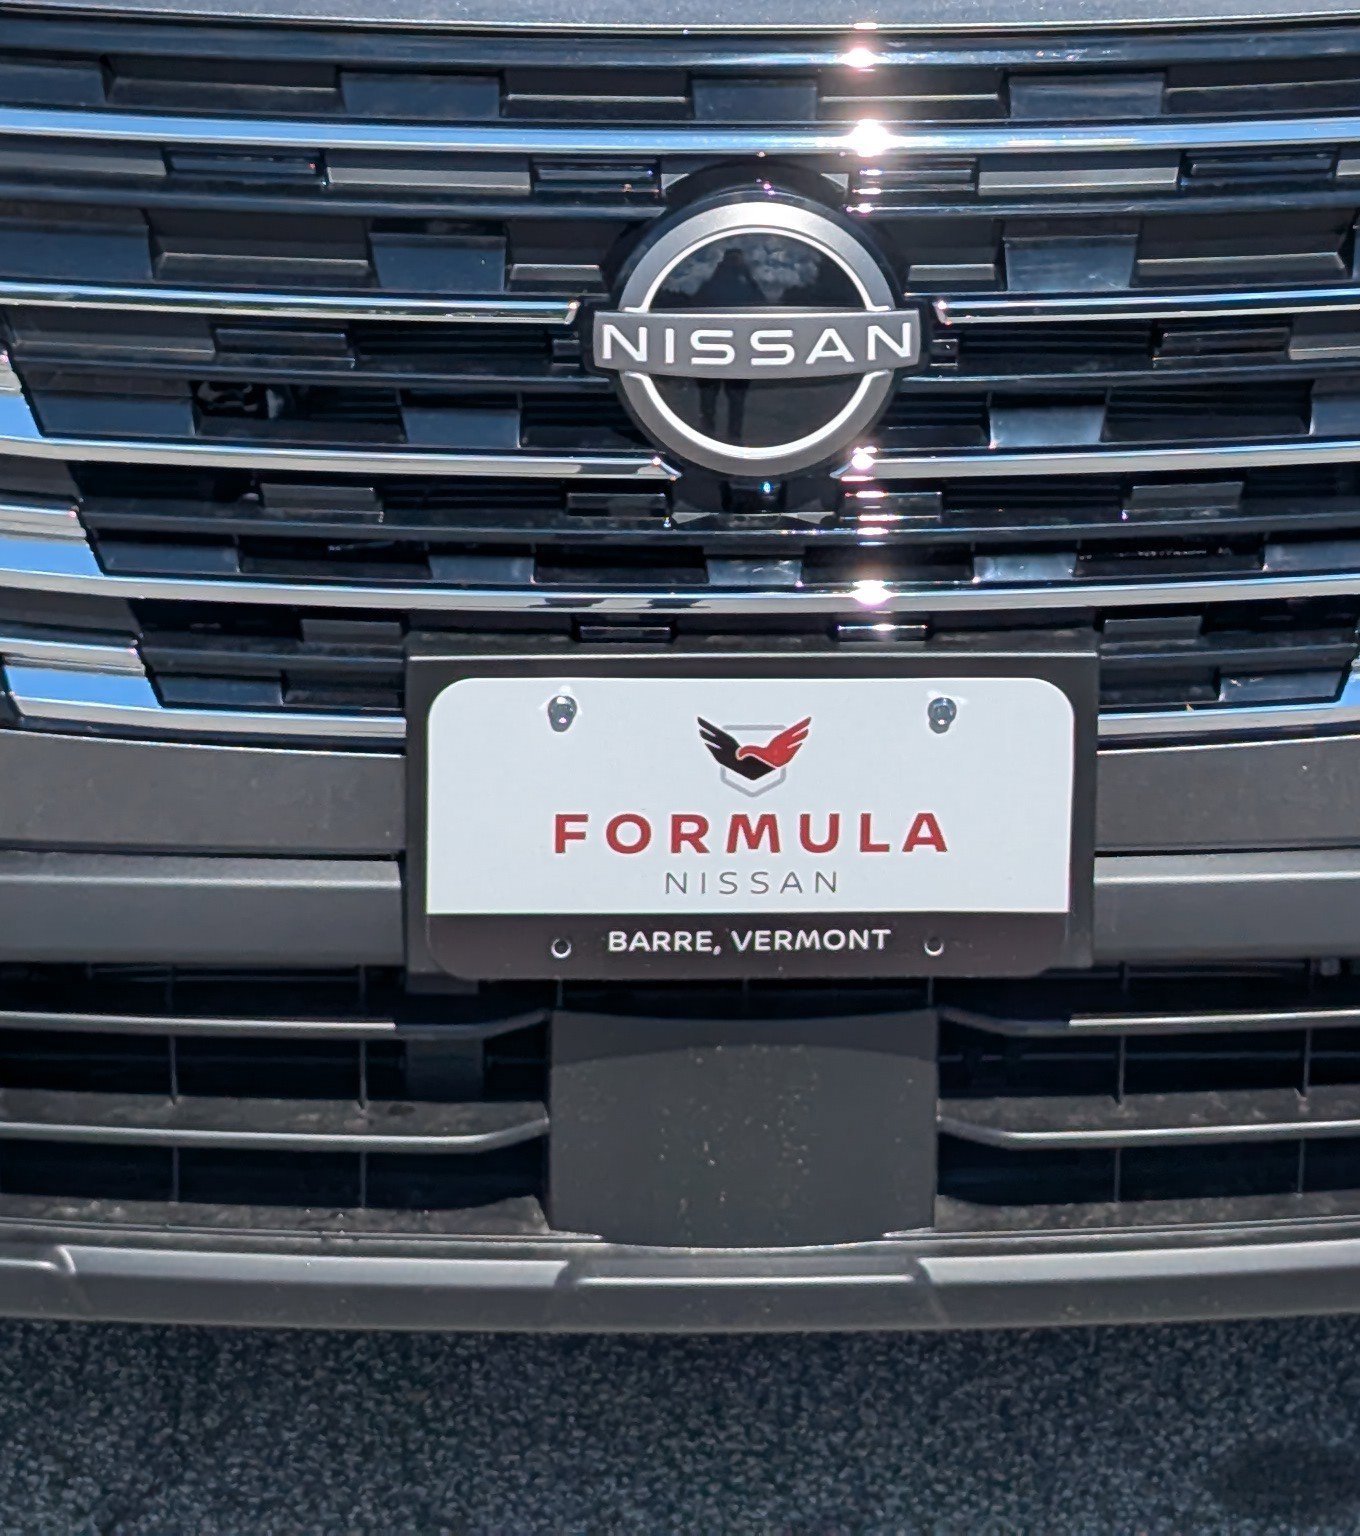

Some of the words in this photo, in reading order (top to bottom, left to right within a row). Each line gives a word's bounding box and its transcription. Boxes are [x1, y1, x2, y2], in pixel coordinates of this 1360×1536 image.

[601, 322, 912, 366] NISSAN
[553, 812, 949, 855] FORMULA
[664, 870, 839, 895] NISSAN
[606, 929, 722, 956] BARRE,
[730, 928, 893, 953] VERMONT
